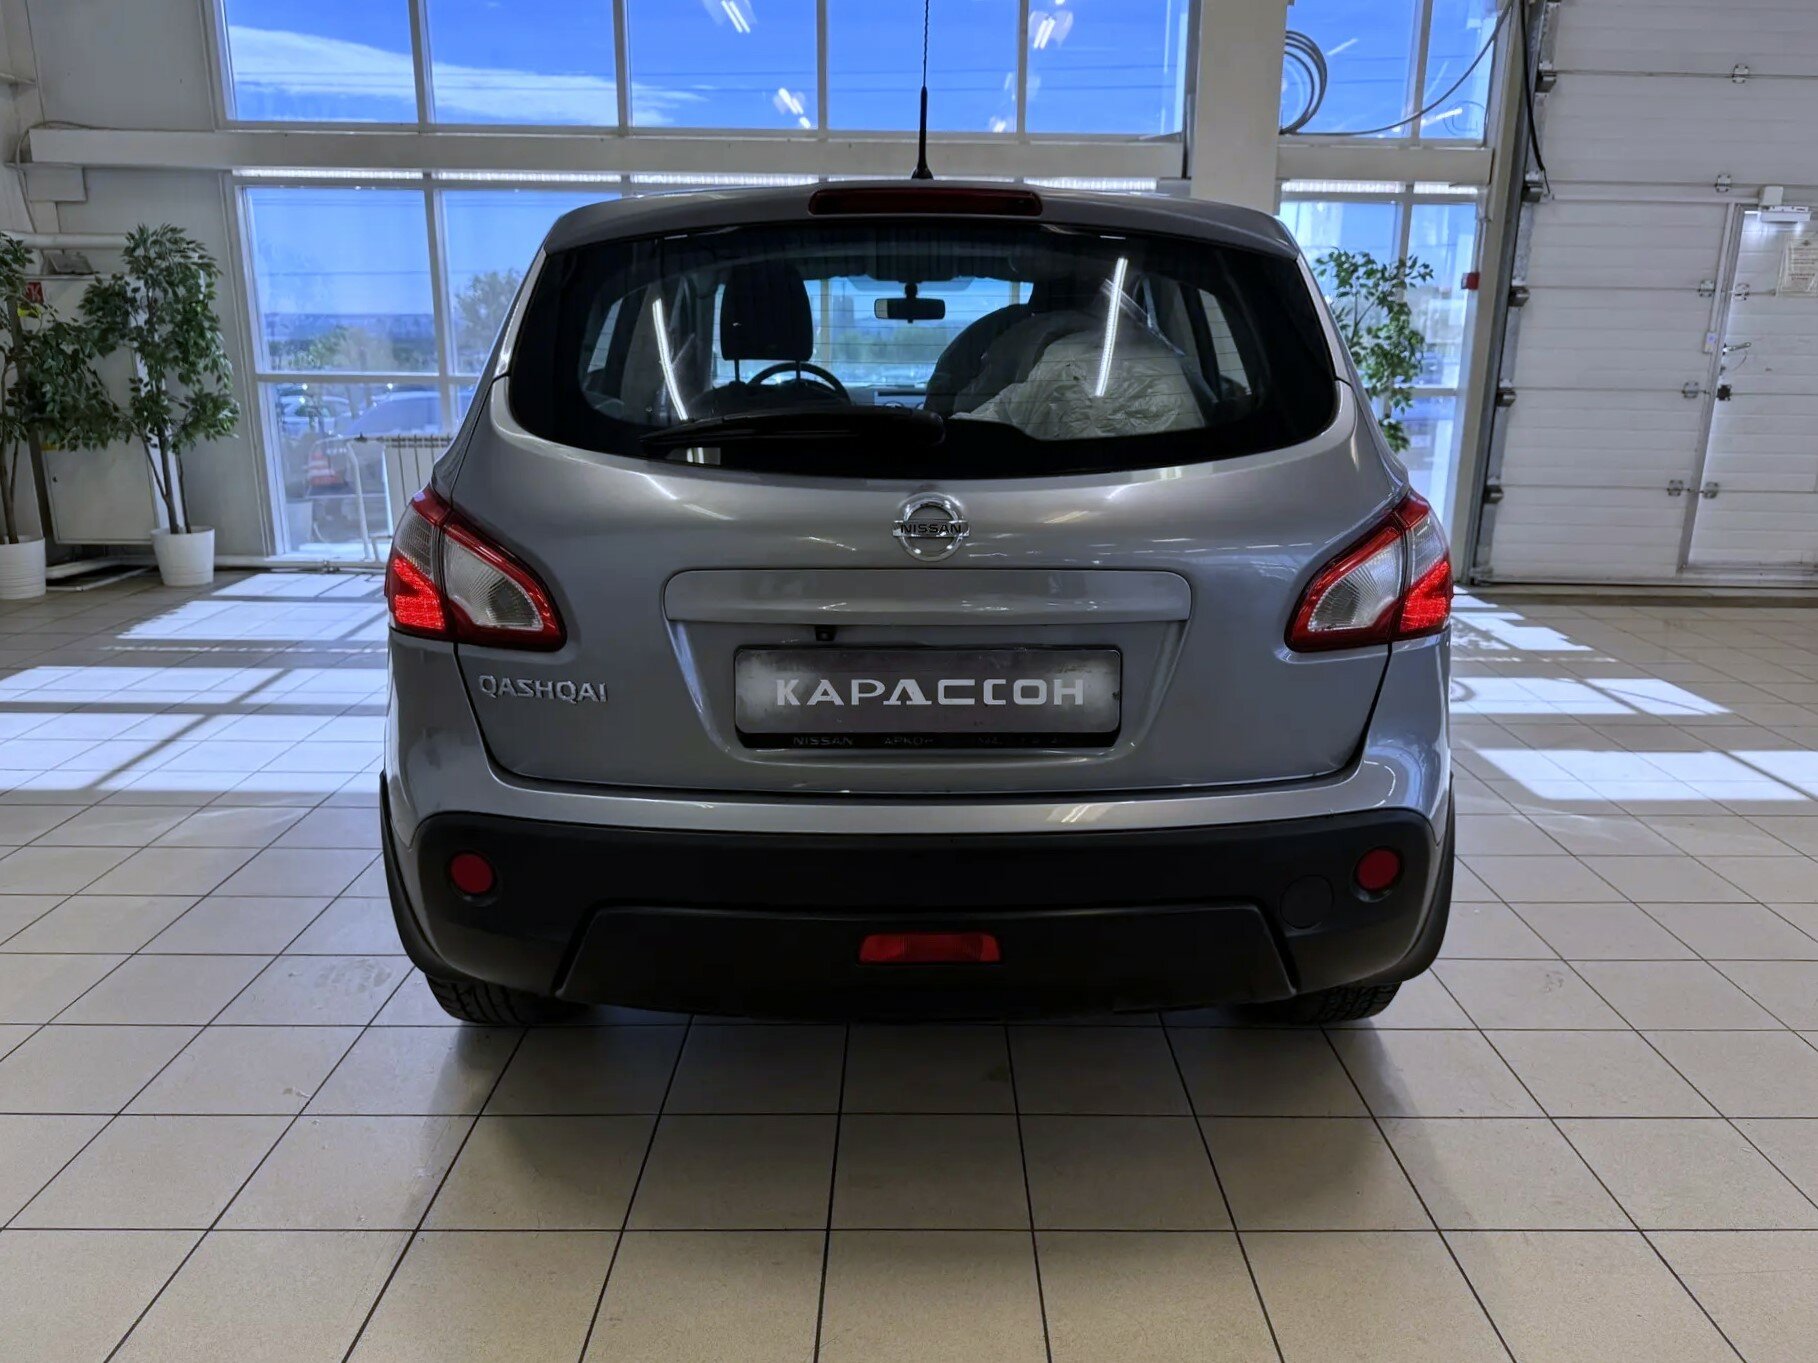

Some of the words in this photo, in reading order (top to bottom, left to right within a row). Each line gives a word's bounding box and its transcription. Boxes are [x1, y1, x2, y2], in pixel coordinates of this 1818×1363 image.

[901, 524, 961, 533] NISSAN
[478, 675, 607, 704] QASHQAI
[776, 679, 1084, 705] КАРЛССОН
[793, 736, 853, 745] NISSAN
